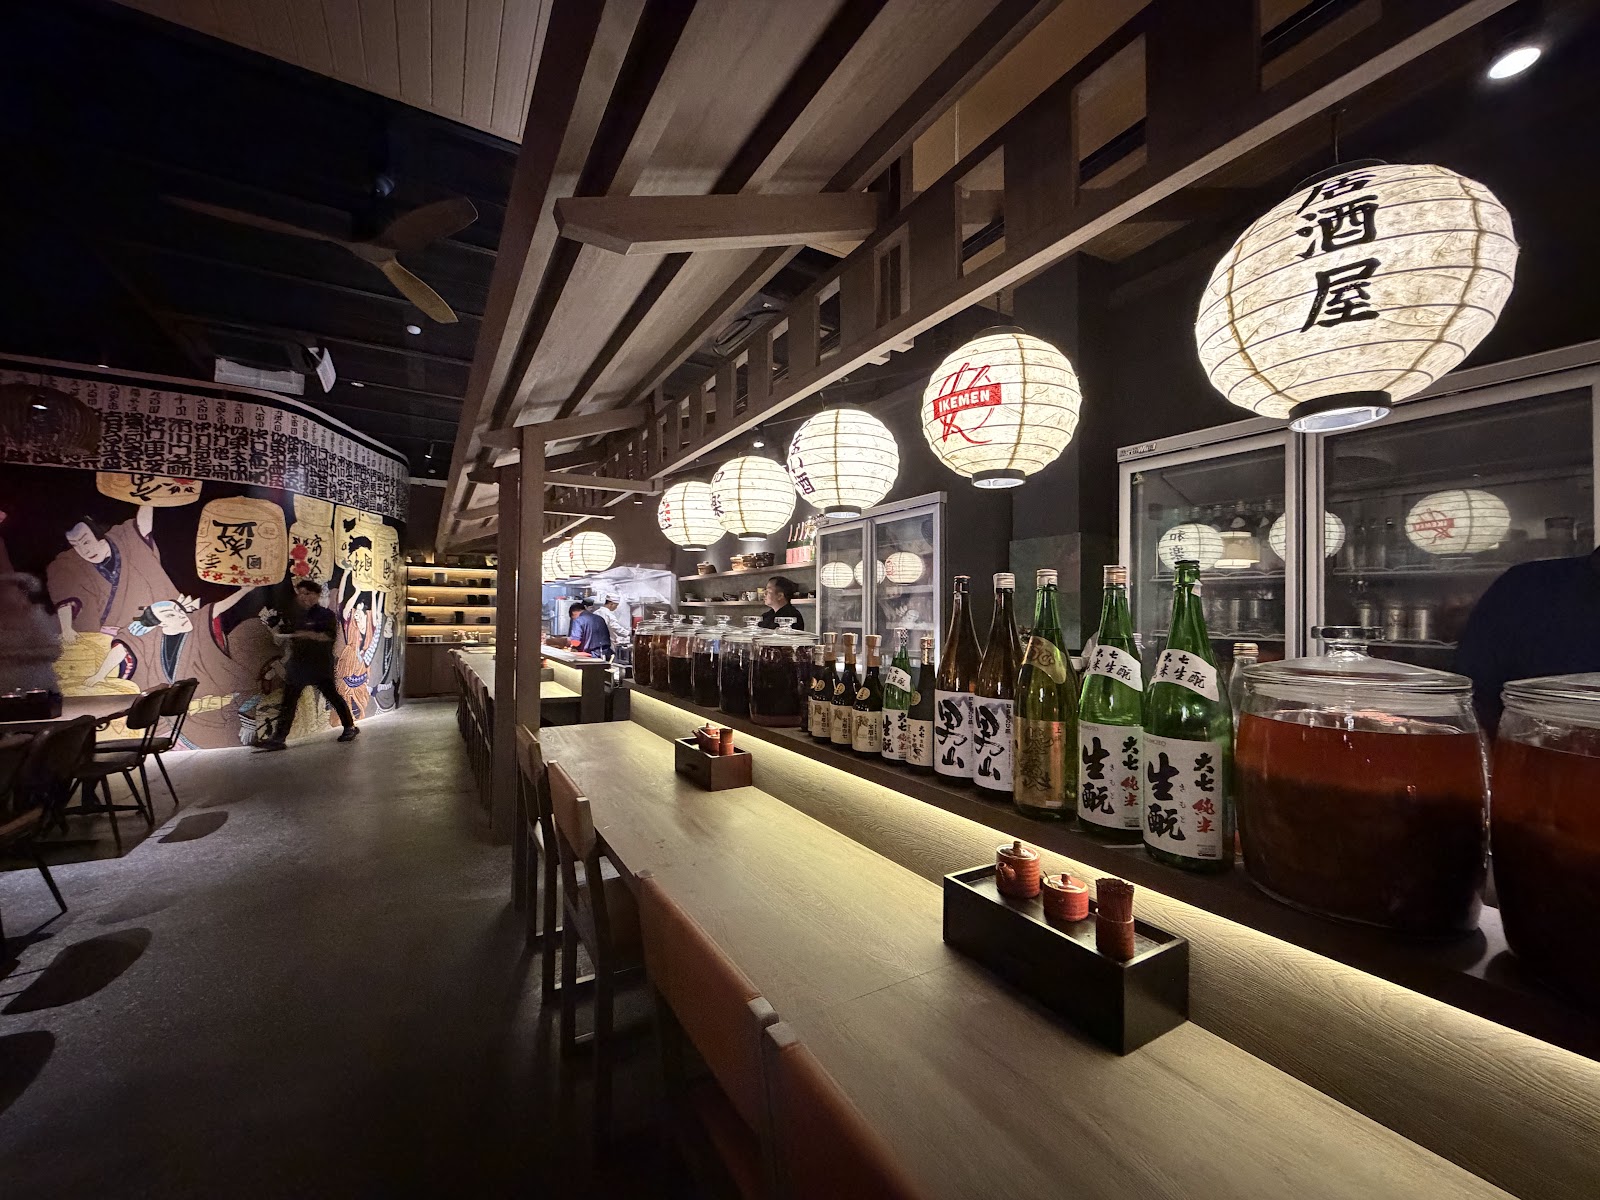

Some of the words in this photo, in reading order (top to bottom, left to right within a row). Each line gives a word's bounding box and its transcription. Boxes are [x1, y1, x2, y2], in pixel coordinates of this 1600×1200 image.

[1296, 172, 1381, 333] 居酒屋
[938, 389, 991, 413] IKEMEN
[974, 705, 1005, 781] 男山
